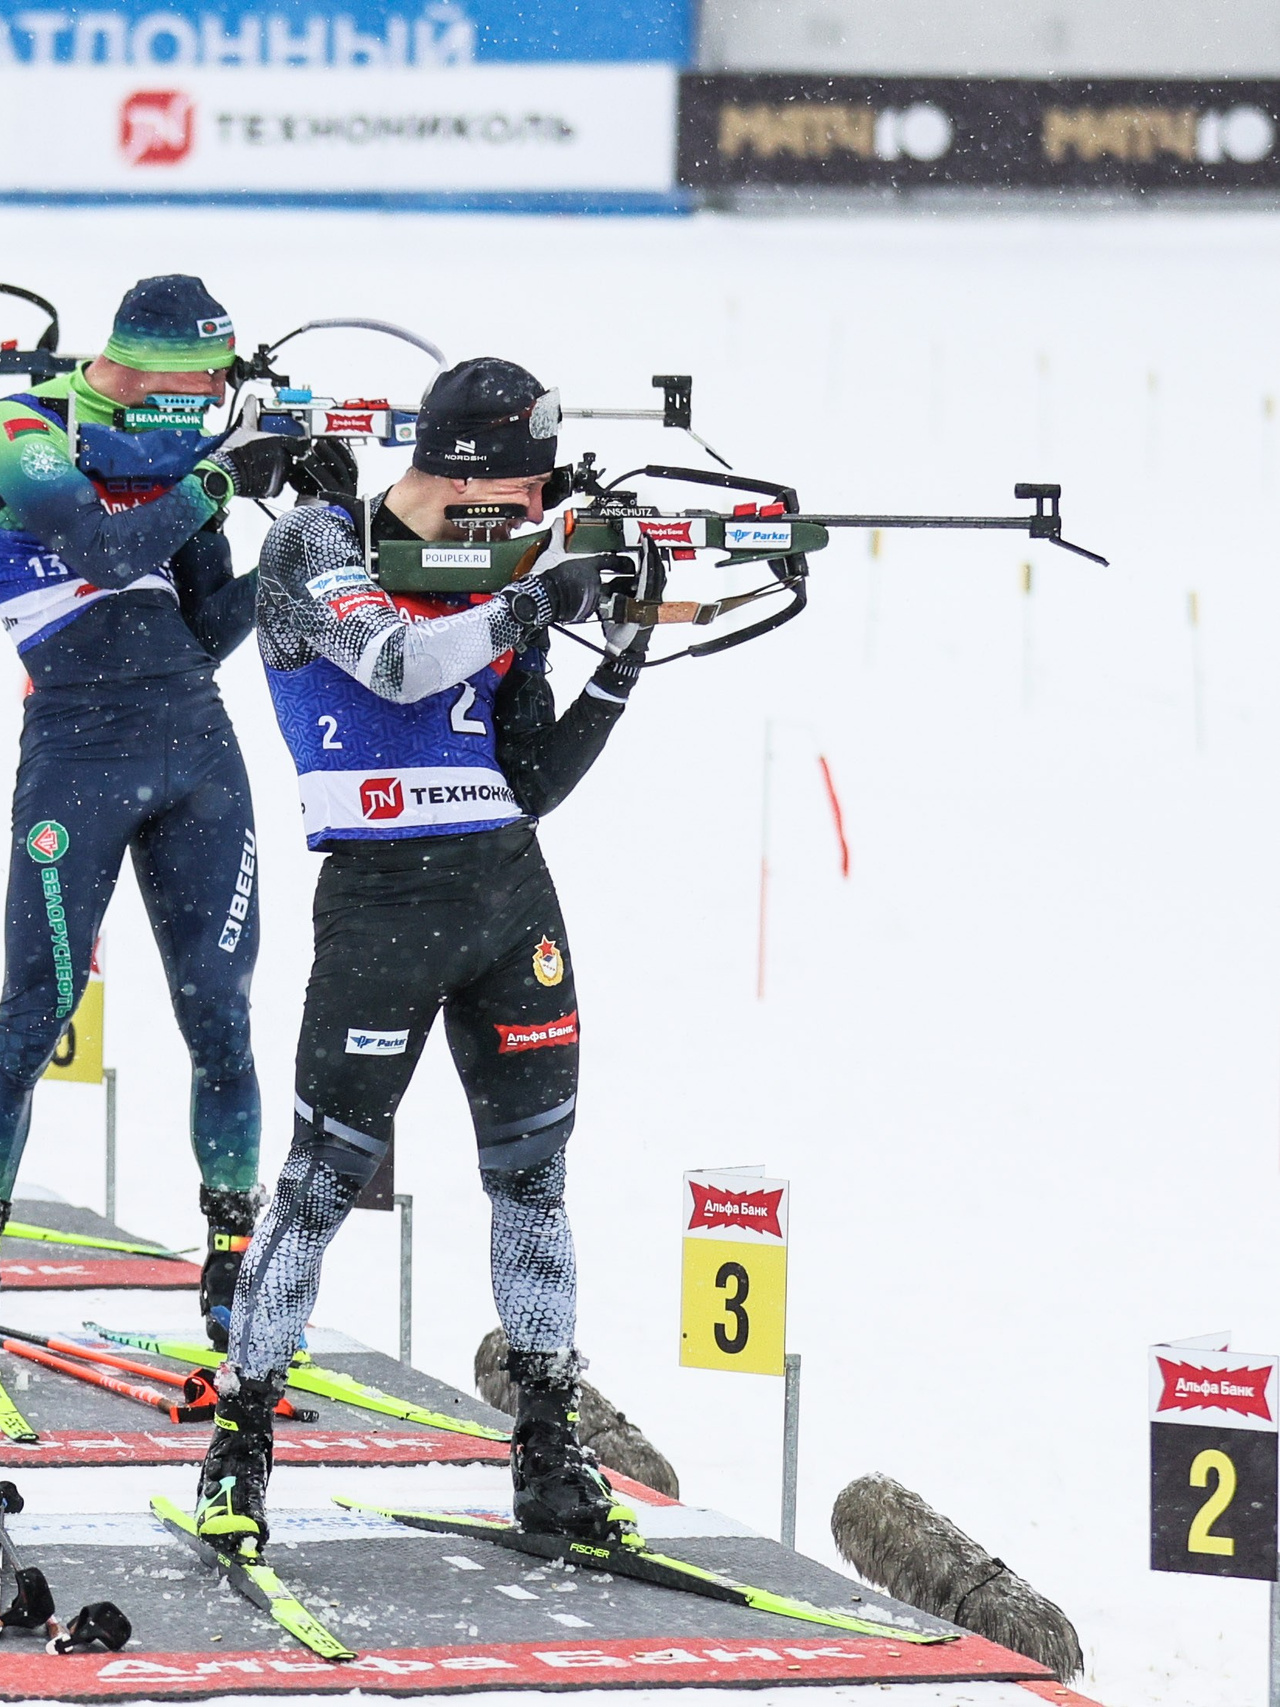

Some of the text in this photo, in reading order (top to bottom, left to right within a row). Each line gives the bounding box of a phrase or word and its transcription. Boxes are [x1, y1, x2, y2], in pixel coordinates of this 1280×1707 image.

[136, 413, 201, 425] БЕЛАРУСБАНК
[444, 453, 487, 461] NORDSKI
[599, 507, 653, 517] ANSCHUTZ
[752, 530, 790, 540] Parker
[28, 554, 69, 577] 13
[425, 553, 488, 564] POLIPLEX.RU
[317, 715, 343, 750] 2
[41, 866, 74, 1019] БЕЛОРУСНЕФТЬ
[377, 1037, 407, 1047] Parker
[507, 1024, 574, 1046] Альфа Банк
[704, 1199, 768, 1217] Альфа Банк
[714, 1262, 749, 1353] 3
[1175, 1377, 1255, 1398] Альфа Банк
[1188, 1449, 1237, 1556] 2
[569, 1542, 611, 1560] FISCHER
[96, 1644, 866, 1684] Альфа Банк
